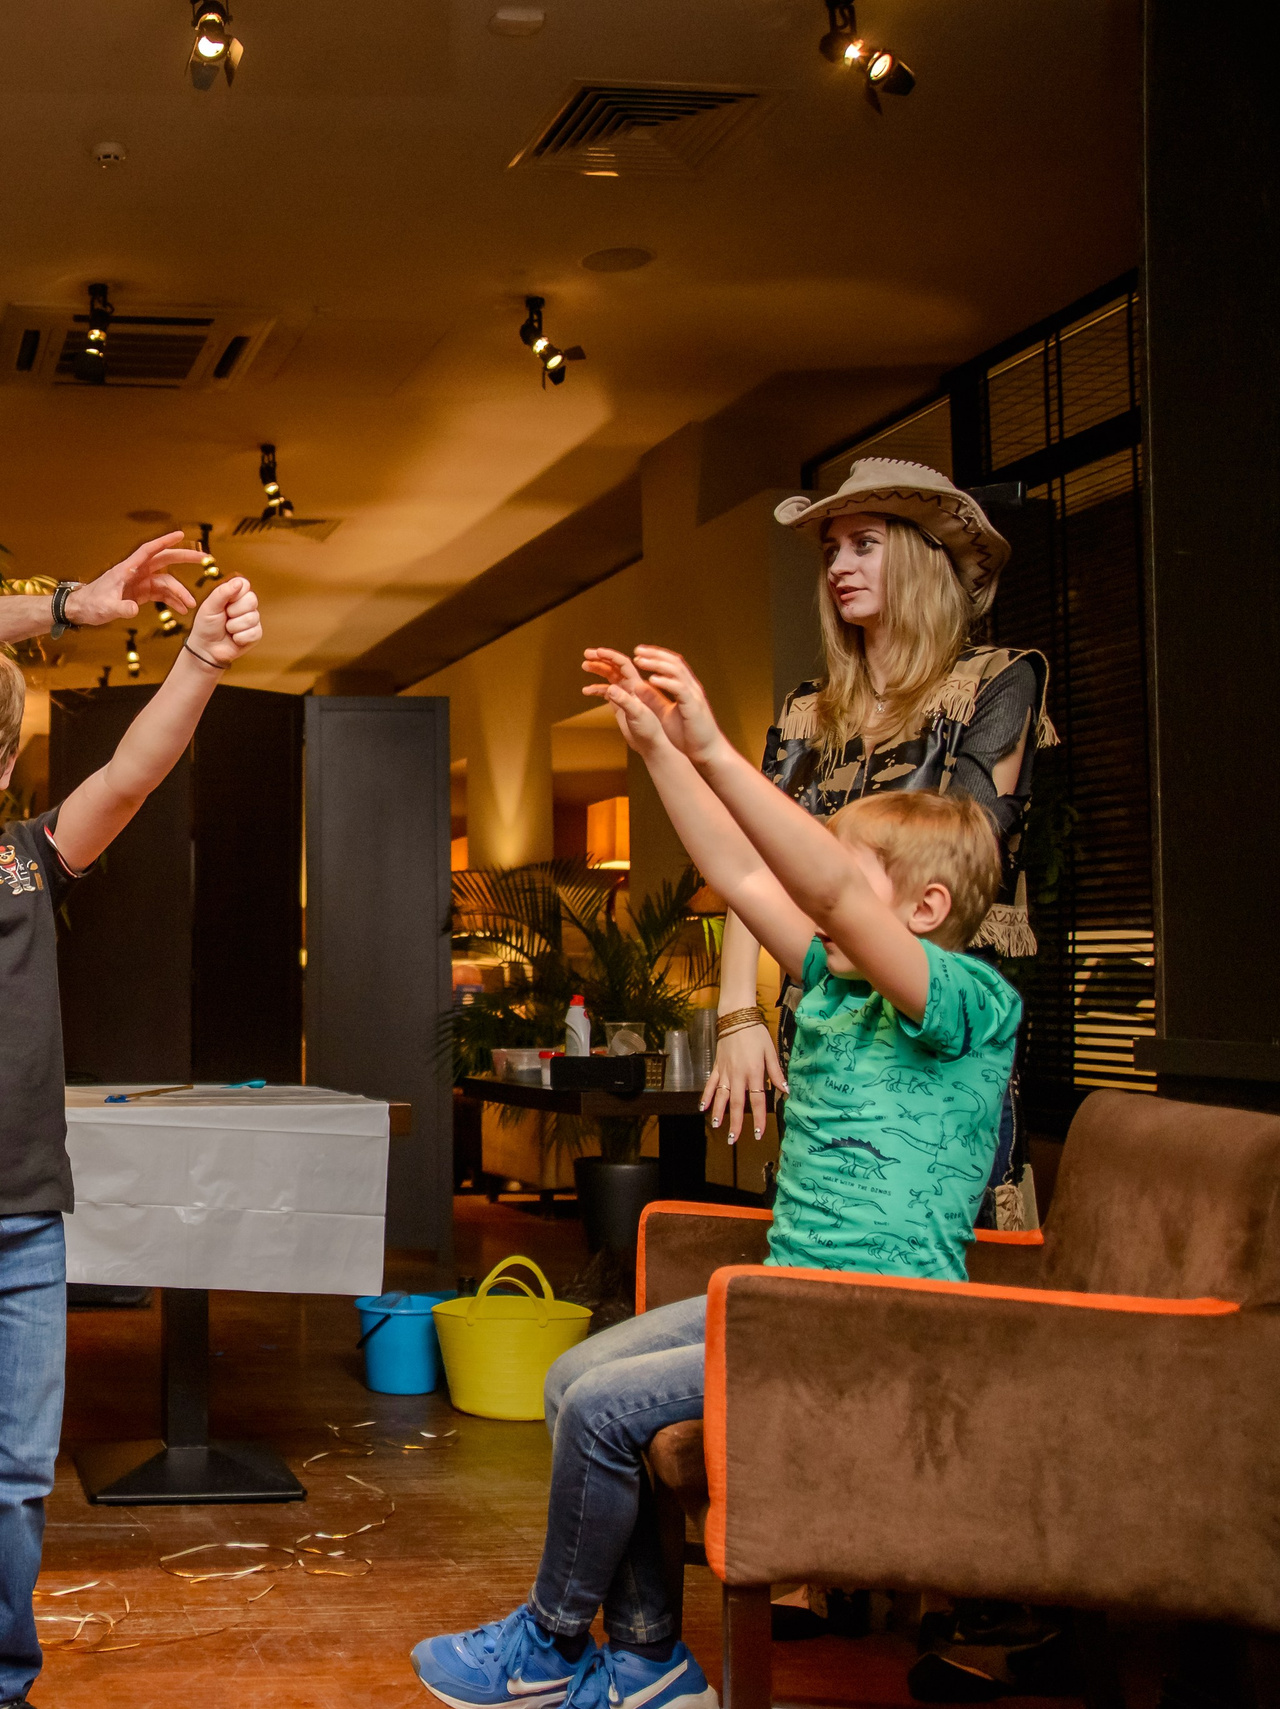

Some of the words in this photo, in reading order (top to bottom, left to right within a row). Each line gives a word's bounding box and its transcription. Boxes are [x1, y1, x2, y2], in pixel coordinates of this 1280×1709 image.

[824, 1076, 855, 1095] RAWR!
[822, 1175, 839, 1183] WALK
[839, 1179, 855, 1187] WITH
[870, 1187, 892, 1196] DINOS
[806, 1229, 839, 1250] RAWR!
